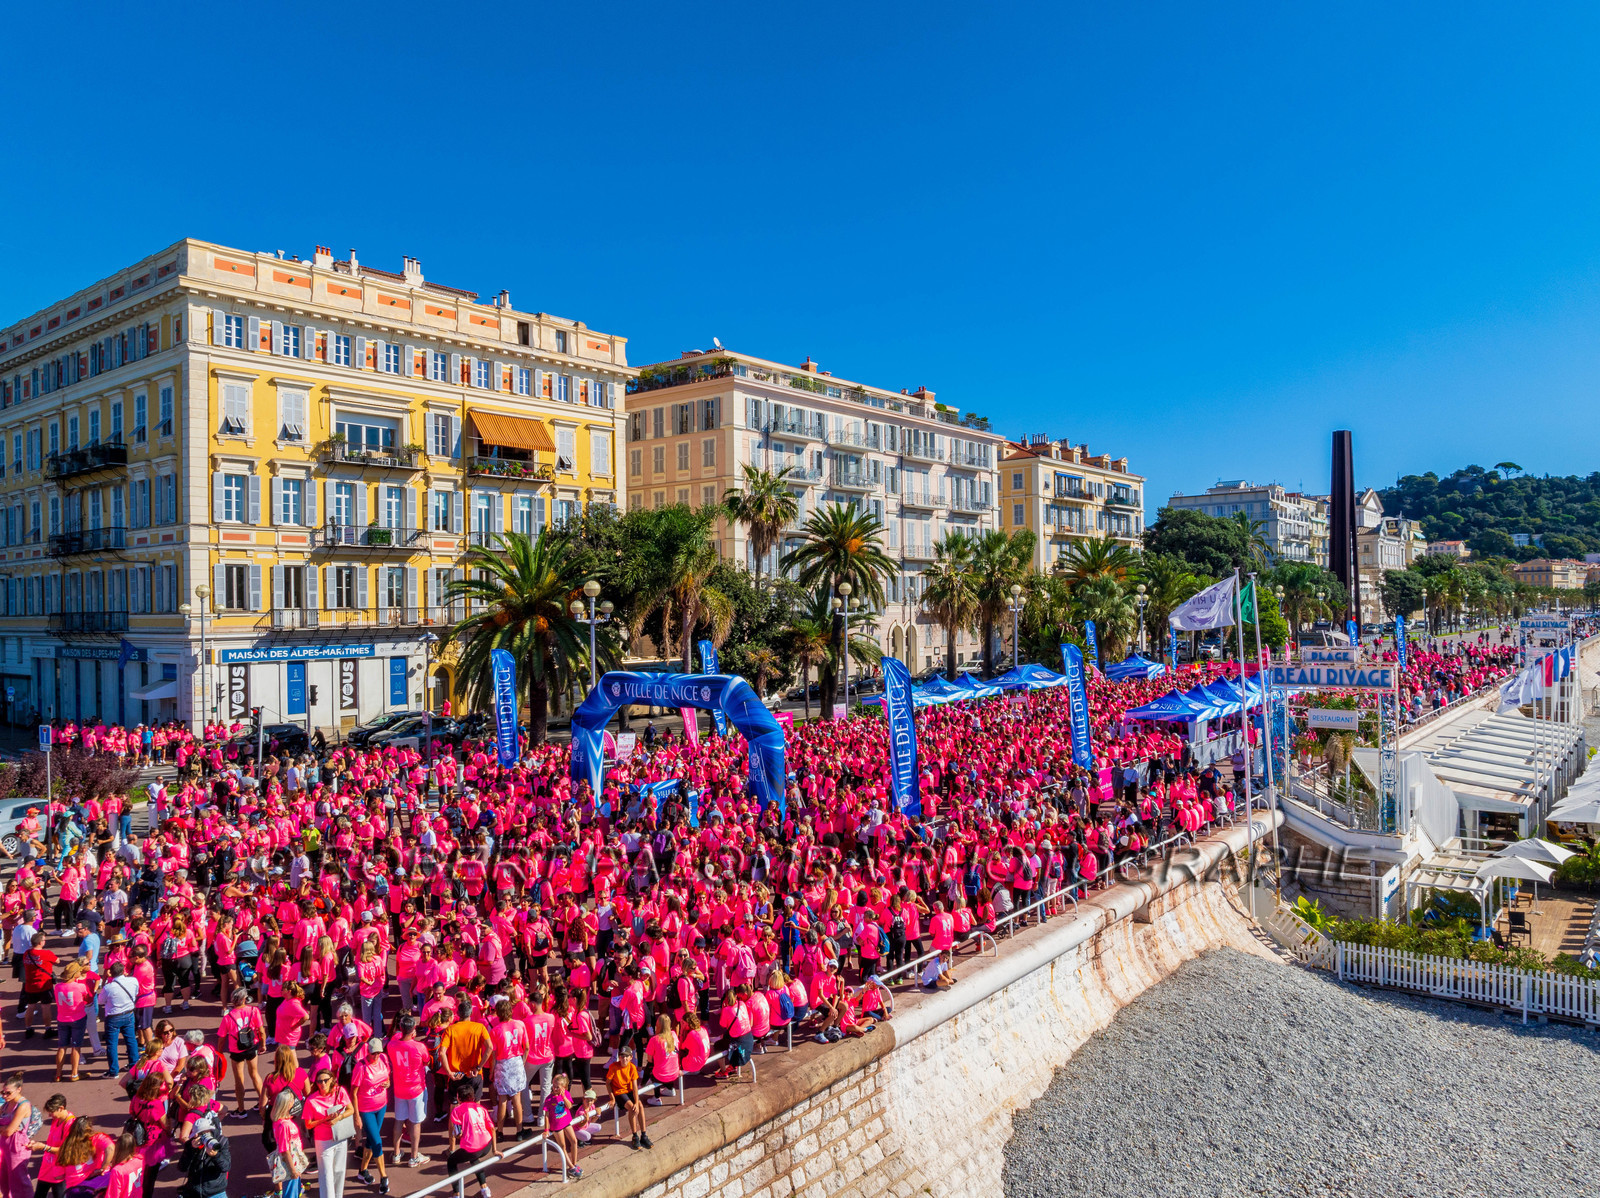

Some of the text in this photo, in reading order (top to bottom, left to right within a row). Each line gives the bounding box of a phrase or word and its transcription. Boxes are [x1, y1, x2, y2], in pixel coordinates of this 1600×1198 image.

[1520, 620, 1568, 628] BEAU RIVAGE
[62, 648, 80, 657] MAISON
[81, 649, 92, 657] DES
[228, 647, 370, 660] MAISON DES ALPES-MARITIMES
[1311, 652, 1349, 661] PLAGE
[342, 661, 354, 708] VOUS
[1274, 667, 1390, 687] BEAU RIVAGE
[231, 666, 245, 717] VOUS
[624, 682, 699, 701] VILLE DE NICE
[498, 666, 514, 749] VILLE DE NICE
[1068, 661, 1087, 748] VILLE DE NICE
[1312, 714, 1354, 723] RESTAURANT
[890, 680, 912, 792] VILLE DE NICE
[468, 867, 475, 877] N
[503, 867, 511, 878] N
[306, 924, 318, 938] N
[941, 919, 951, 931] N
[446, 967, 455, 982] N
[57, 991, 74, 1006] N
[504, 1029, 518, 1048] N
[534, 1022, 548, 1039] N
[395, 1050, 409, 1067] N
[468, 1107, 485, 1125] N
[127, 1167, 143, 1197] N
